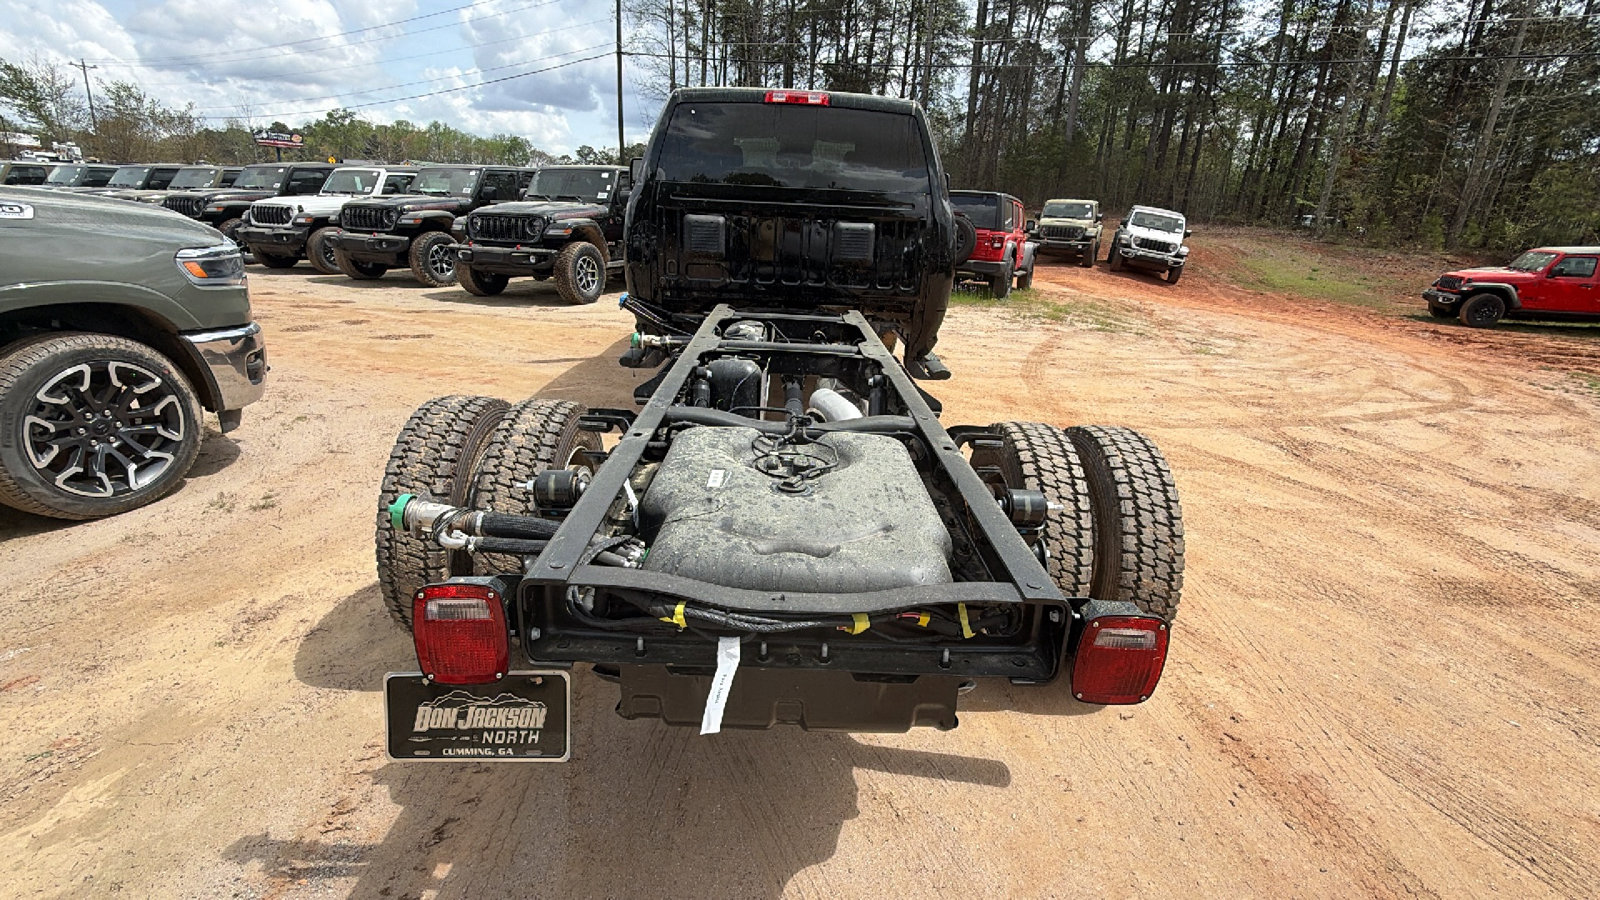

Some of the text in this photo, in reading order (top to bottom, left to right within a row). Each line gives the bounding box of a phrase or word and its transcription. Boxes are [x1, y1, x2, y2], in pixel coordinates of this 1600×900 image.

[413, 706, 548, 732] DON JACKSON
[482, 730, 540, 744] NORTH
[442, 748, 514, 756] CUMMING, GA
